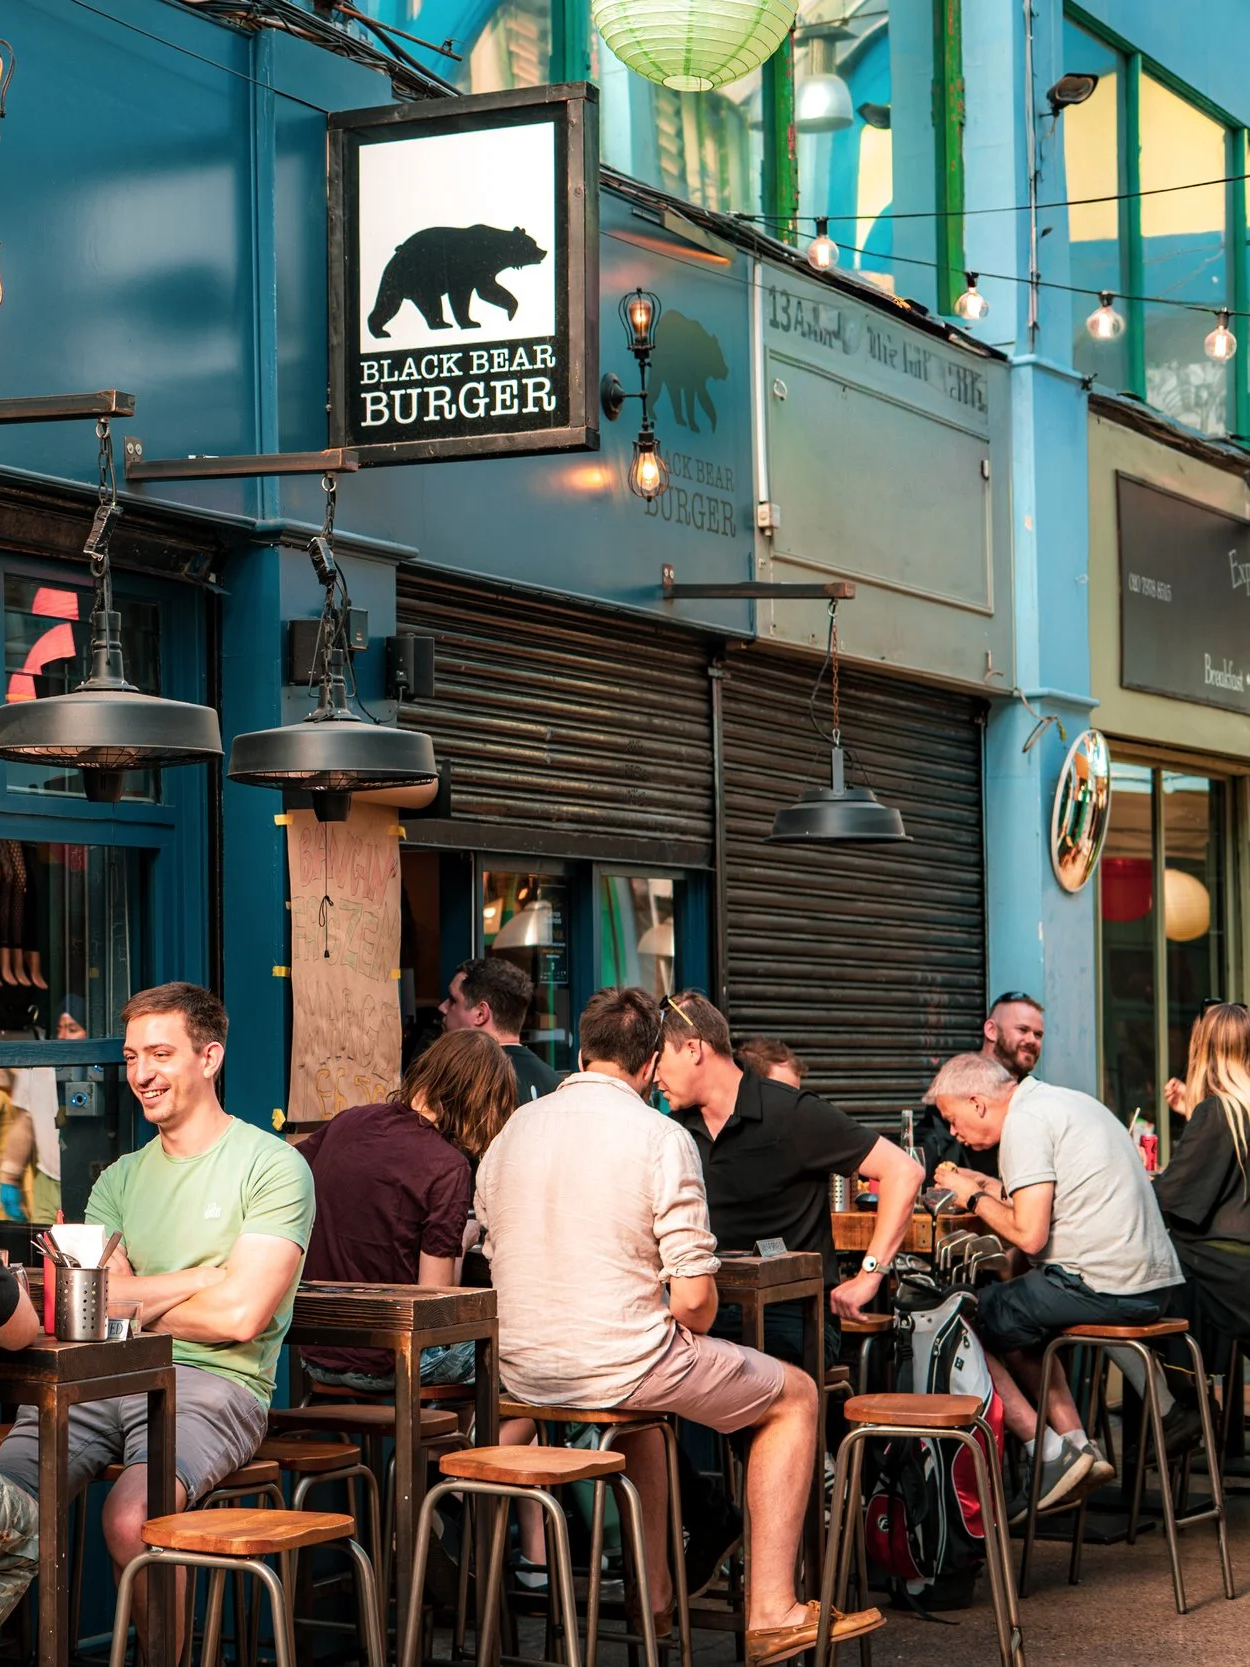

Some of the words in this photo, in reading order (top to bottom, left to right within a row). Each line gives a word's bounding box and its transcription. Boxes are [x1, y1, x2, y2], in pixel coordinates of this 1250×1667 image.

[360, 353, 463, 385] BLACK
[469, 344, 556, 376] BEAR
[360, 375, 557, 427] BURGER
[695, 458, 735, 493] BEAR
[1204, 653, 1244, 692] Breakfast
